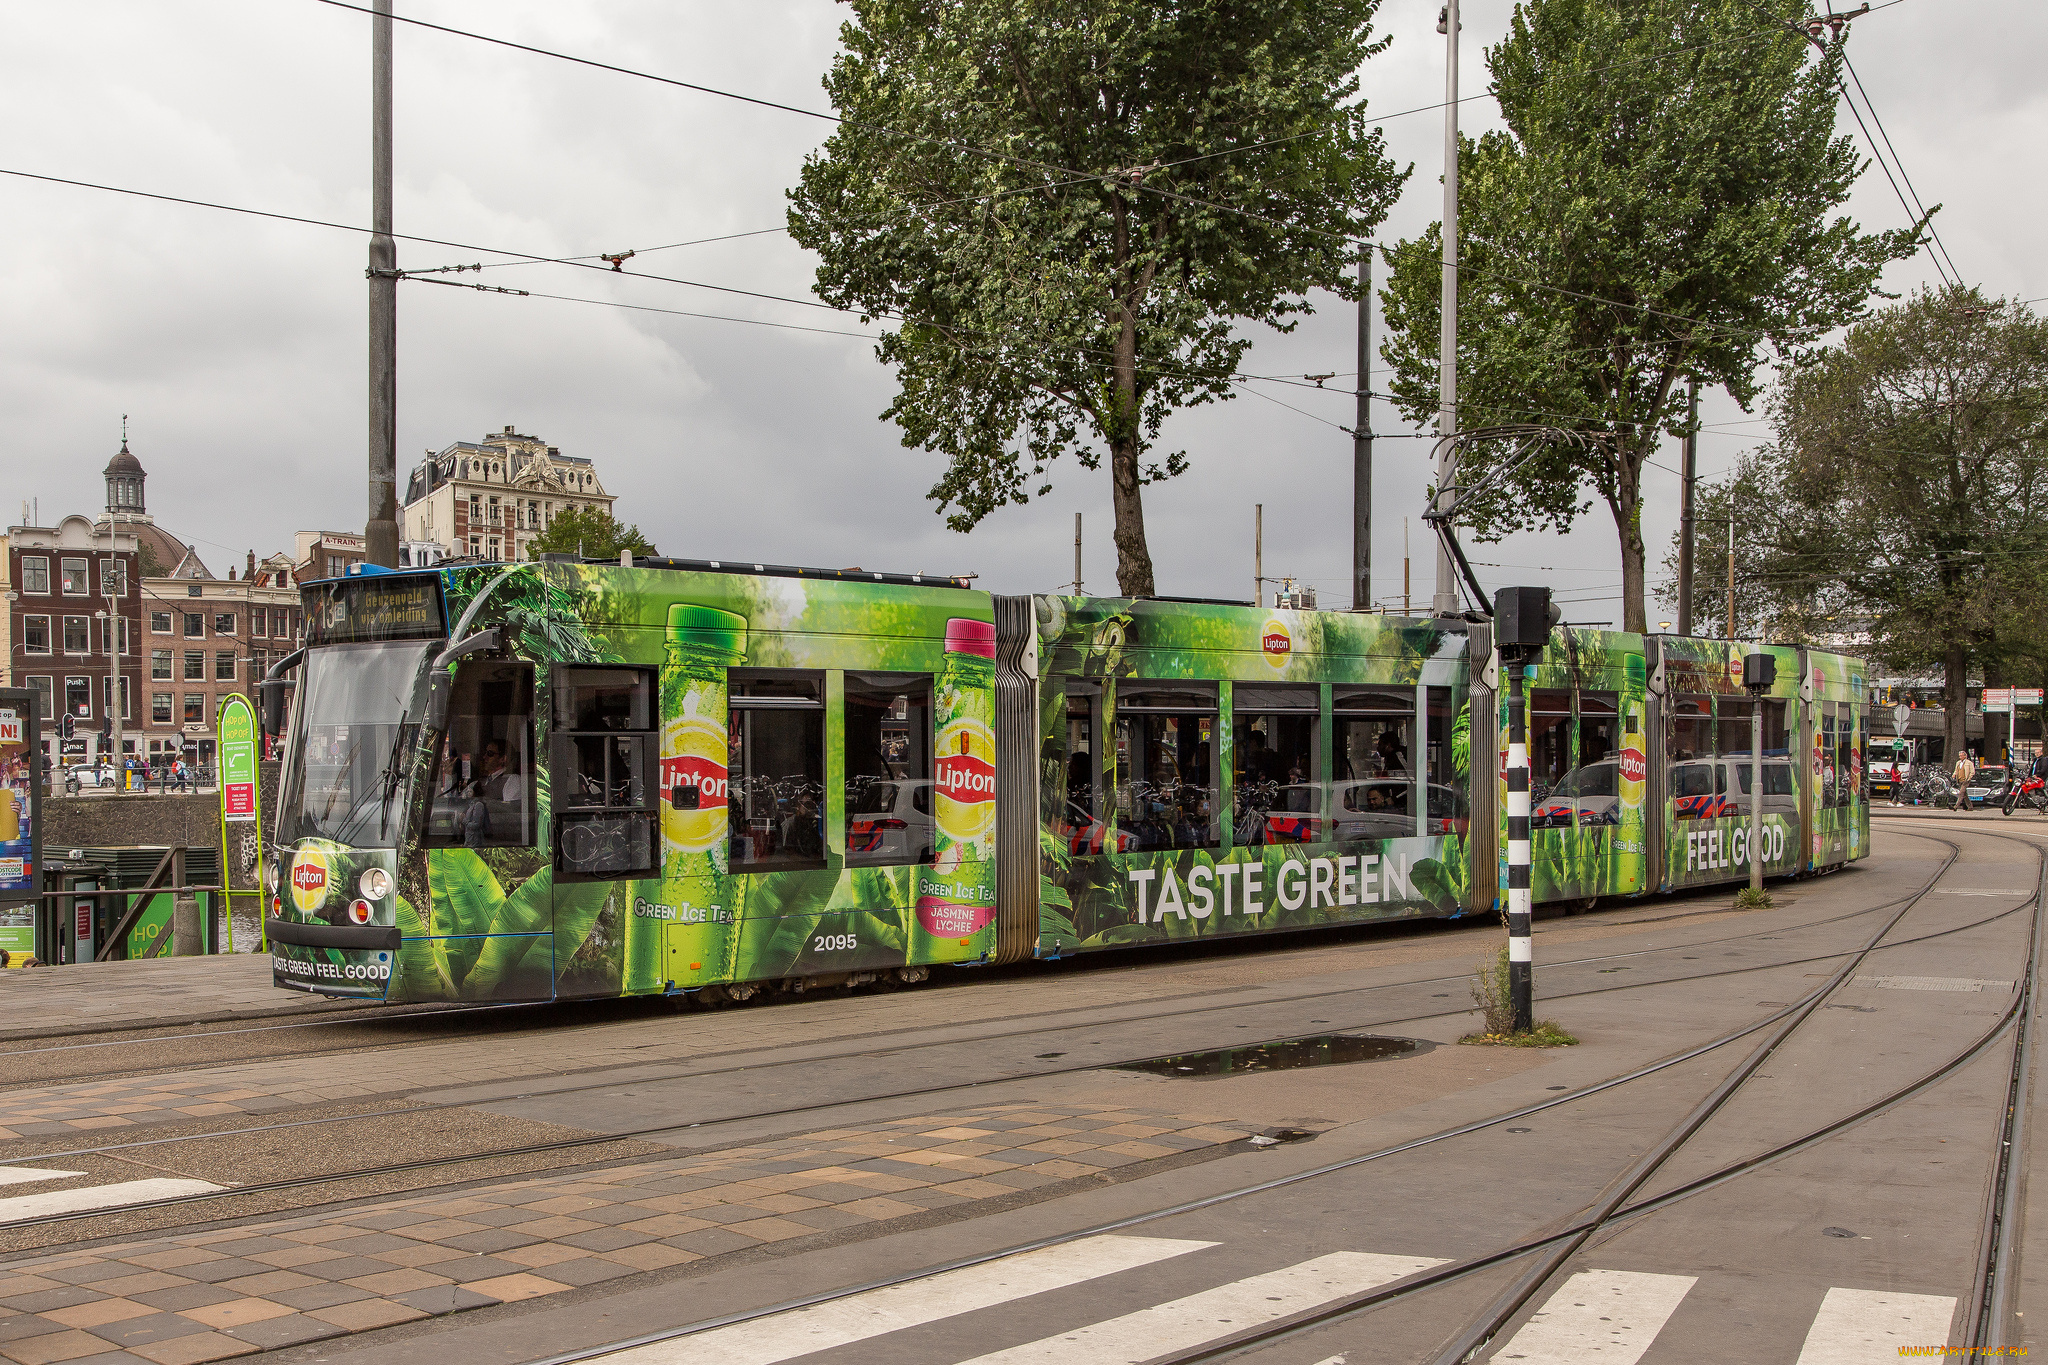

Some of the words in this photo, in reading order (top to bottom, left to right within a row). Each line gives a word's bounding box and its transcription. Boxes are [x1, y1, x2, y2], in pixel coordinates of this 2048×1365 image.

[365, 588, 422, 608] Geuzenveld
[320, 596, 335, 629] 13
[361, 610, 375, 624] via
[379, 608, 427, 623] omleiding
[1265, 638, 1288, 651] Lipton
[225, 716, 237, 727] HOP
[238, 715, 247, 726] ON
[226, 729, 238, 740] HOP
[239, 728, 249, 739] OFF
[1619, 754, 1646, 775] Lipton
[936, 763, 995, 794] Lipton
[1611, 836, 1627, 851] GREEN
[1628, 839, 1637, 853] ICE
[1687, 829, 1728, 872] FEEL
[295, 869, 322, 885] Lipton
[919, 877, 952, 897] GREEN
[956, 881, 974, 900] ICE
[978, 884, 995, 901] TEA
[1129, 861, 1264, 924] TASTE
[1277, 852, 1408, 911] GREEN
[634, 896, 677, 920] GREEN
[680, 901, 707, 922] ICE
[710, 904, 734, 925] TEA
[931, 906, 975, 921] JASMINE
[134, 923, 163, 942] HO
[936, 919, 972, 933] LYCHEE
[131, 944, 168, 959] HP
[814, 934, 857, 952] 2095
[273, 955, 289, 972] TASTE
[287, 959, 315, 977] GREEN
[316, 963, 344, 979] FEEL
[345, 964, 391, 980] GOOD
